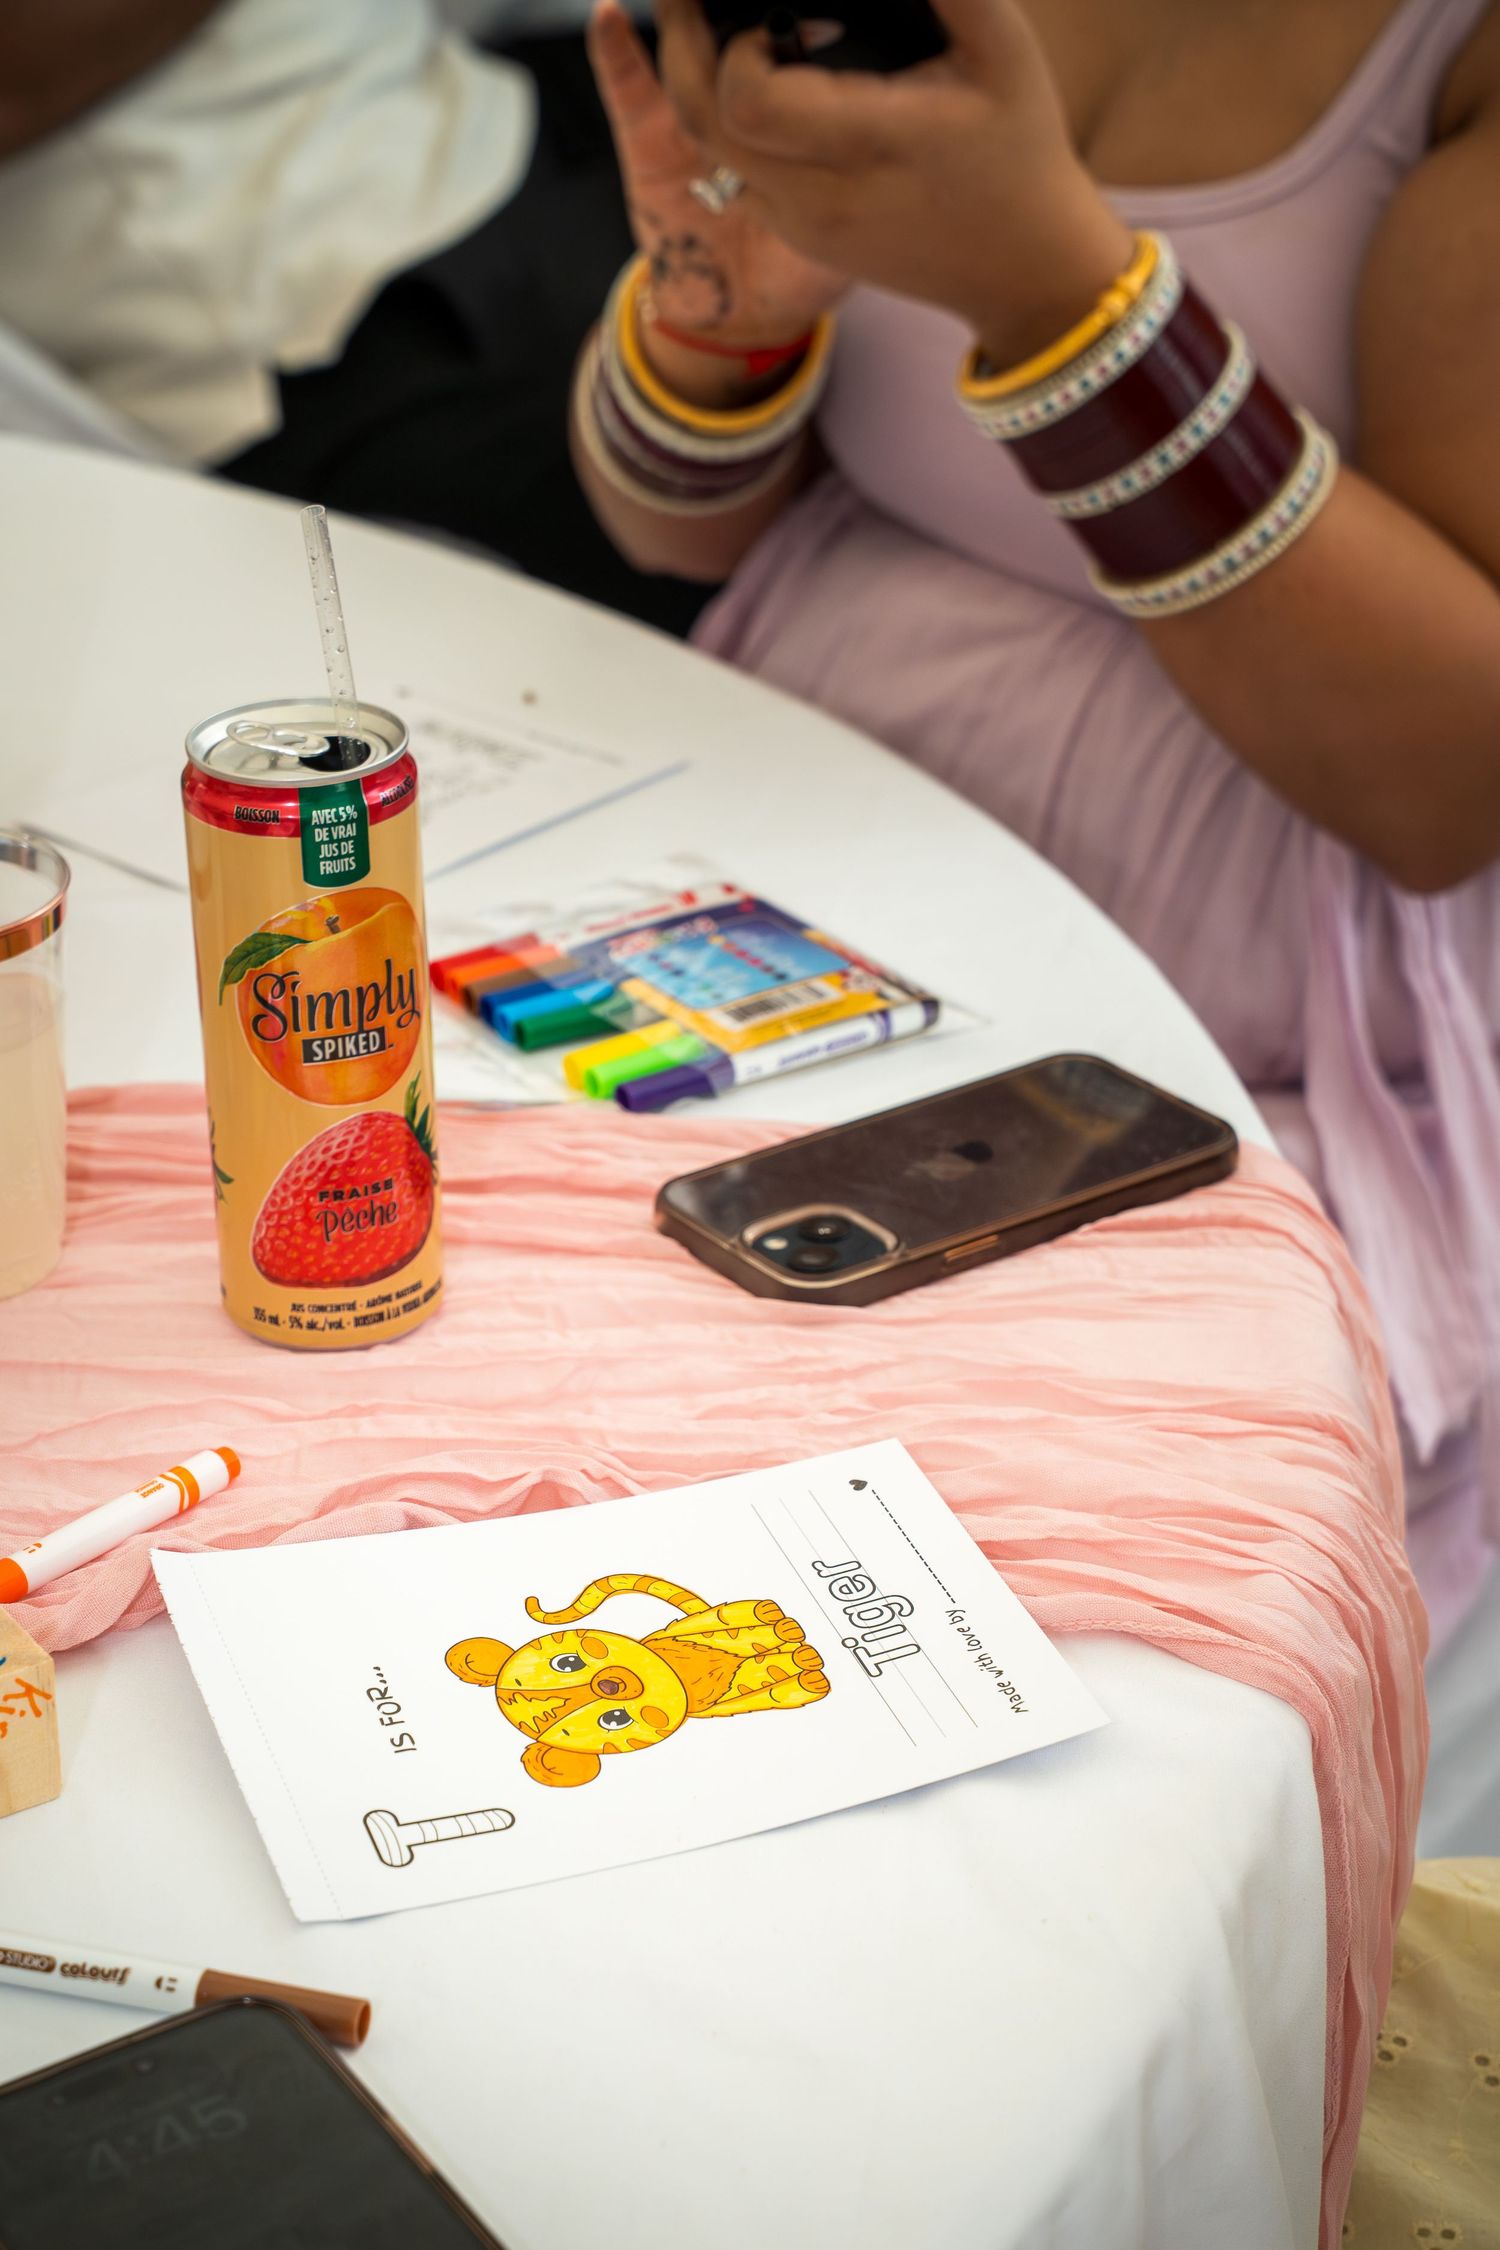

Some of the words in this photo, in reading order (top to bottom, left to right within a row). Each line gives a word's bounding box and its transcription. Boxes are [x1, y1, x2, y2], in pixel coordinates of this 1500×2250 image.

[234, 806, 280, 823] BOISSON
[311, 807, 337, 825] AVEC
[338, 804, 358, 821] 5%
[314, 826, 330, 842] DE
[330, 822, 357, 840] VRAI
[319, 843, 339, 859] JUS
[340, 840, 355, 855] DE
[320, 858, 356, 875] FRUITS
[252, 958, 421, 1042] Simply
[312, 1030, 381, 1061] SPIKED
[319, 1177, 393, 1202] FRAISE
[288, 1315, 303, 1329] 5%
[811, 1560, 921, 1678] Tiger
[945, 1608, 966, 1624] by
[956, 1623, 983, 1653] love
[973, 1651, 1004, 1677] with
[996, 1677, 1029, 1714] Made
[389, 1732, 417, 1753] IS
